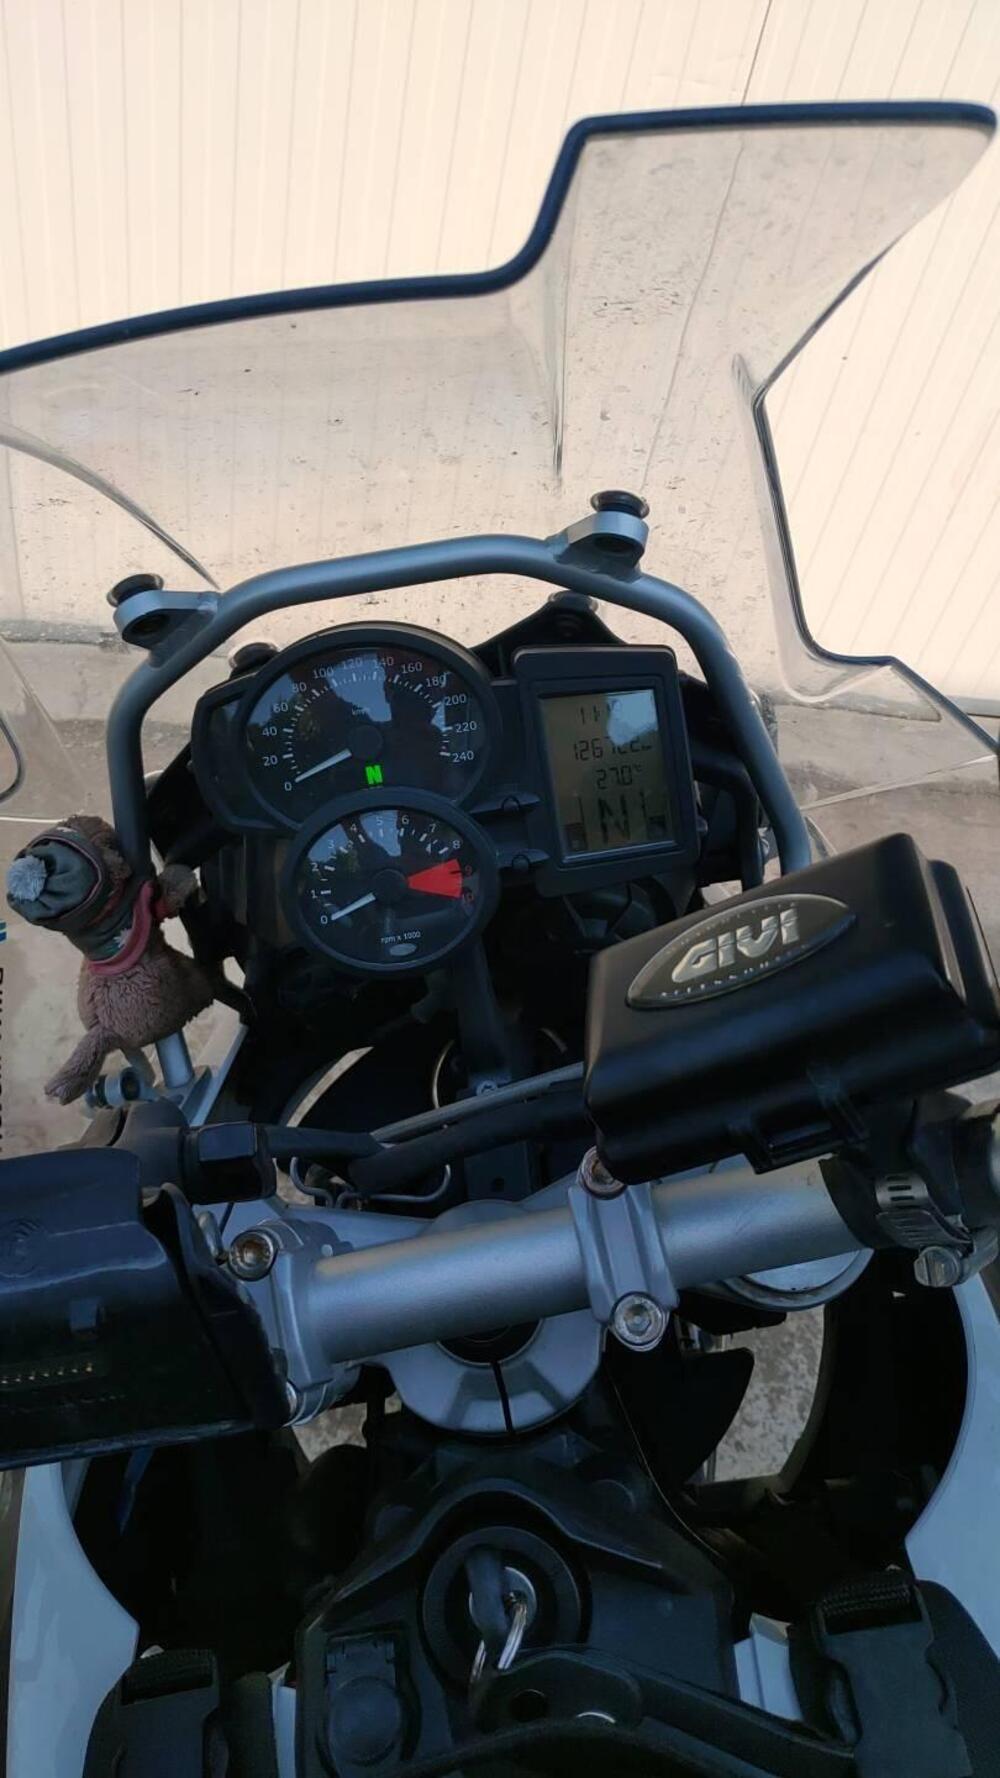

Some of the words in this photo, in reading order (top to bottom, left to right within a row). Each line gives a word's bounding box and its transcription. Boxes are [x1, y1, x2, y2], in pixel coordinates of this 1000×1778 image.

[342, 657, 363, 669] 120
[373, 657, 394, 669] 140
[401, 661, 423, 674] 160
[313, 666, 334, 679] 100
[426, 674, 446, 688] 180
[292, 682, 307, 693] 80
[444, 693, 467, 706] 200
[273, 702, 288, 713] 60
[262, 726, 277, 737] 40
[455, 720, 478, 733] 220
[263, 756, 278, 767] 20
[452, 750, 475, 763] 240
[365, 765, 383, 784] N
[284, 782, 292, 791] 0
[376, 816, 383, 826] 5
[402, 815, 409, 825] 6
[598, 794, 631, 844] N
[350, 823, 357, 833] 4
[430, 823, 437, 833] 7
[328, 839, 335, 849] 3
[452, 839, 460, 849] 8
[312, 862, 319, 872] 2
[311, 889, 318, 899] 1
[320, 915, 328, 925] 0
[403, 931, 421, 940] 1000
[672, 908, 799, 983] GIVI
